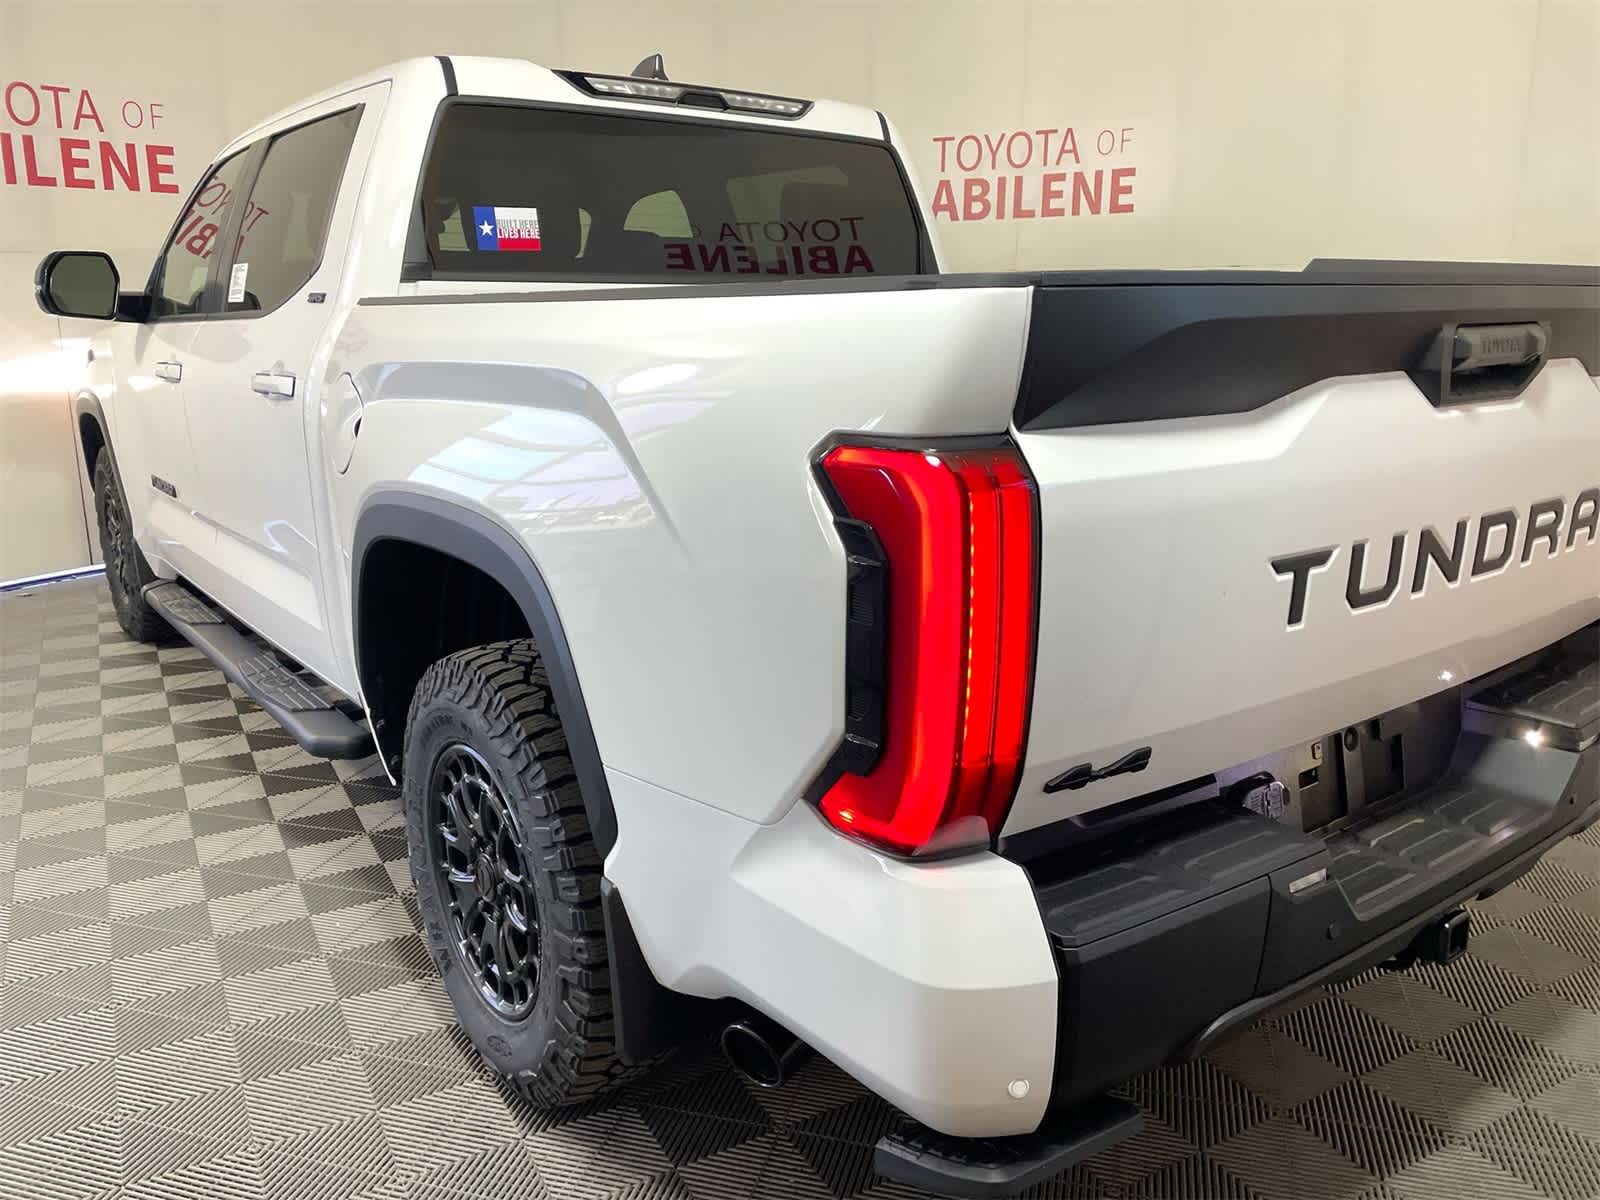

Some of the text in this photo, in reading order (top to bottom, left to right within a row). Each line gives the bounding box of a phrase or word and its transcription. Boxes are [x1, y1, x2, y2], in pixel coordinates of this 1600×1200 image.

[122, 101, 164, 129] OF
[933, 128, 1135, 172] TOYOTA OF
[932, 168, 1136, 221] ABILENE
[497, 227, 541, 239] LIVES HERE
[1268, 487, 1600, 628] TUNDRA
